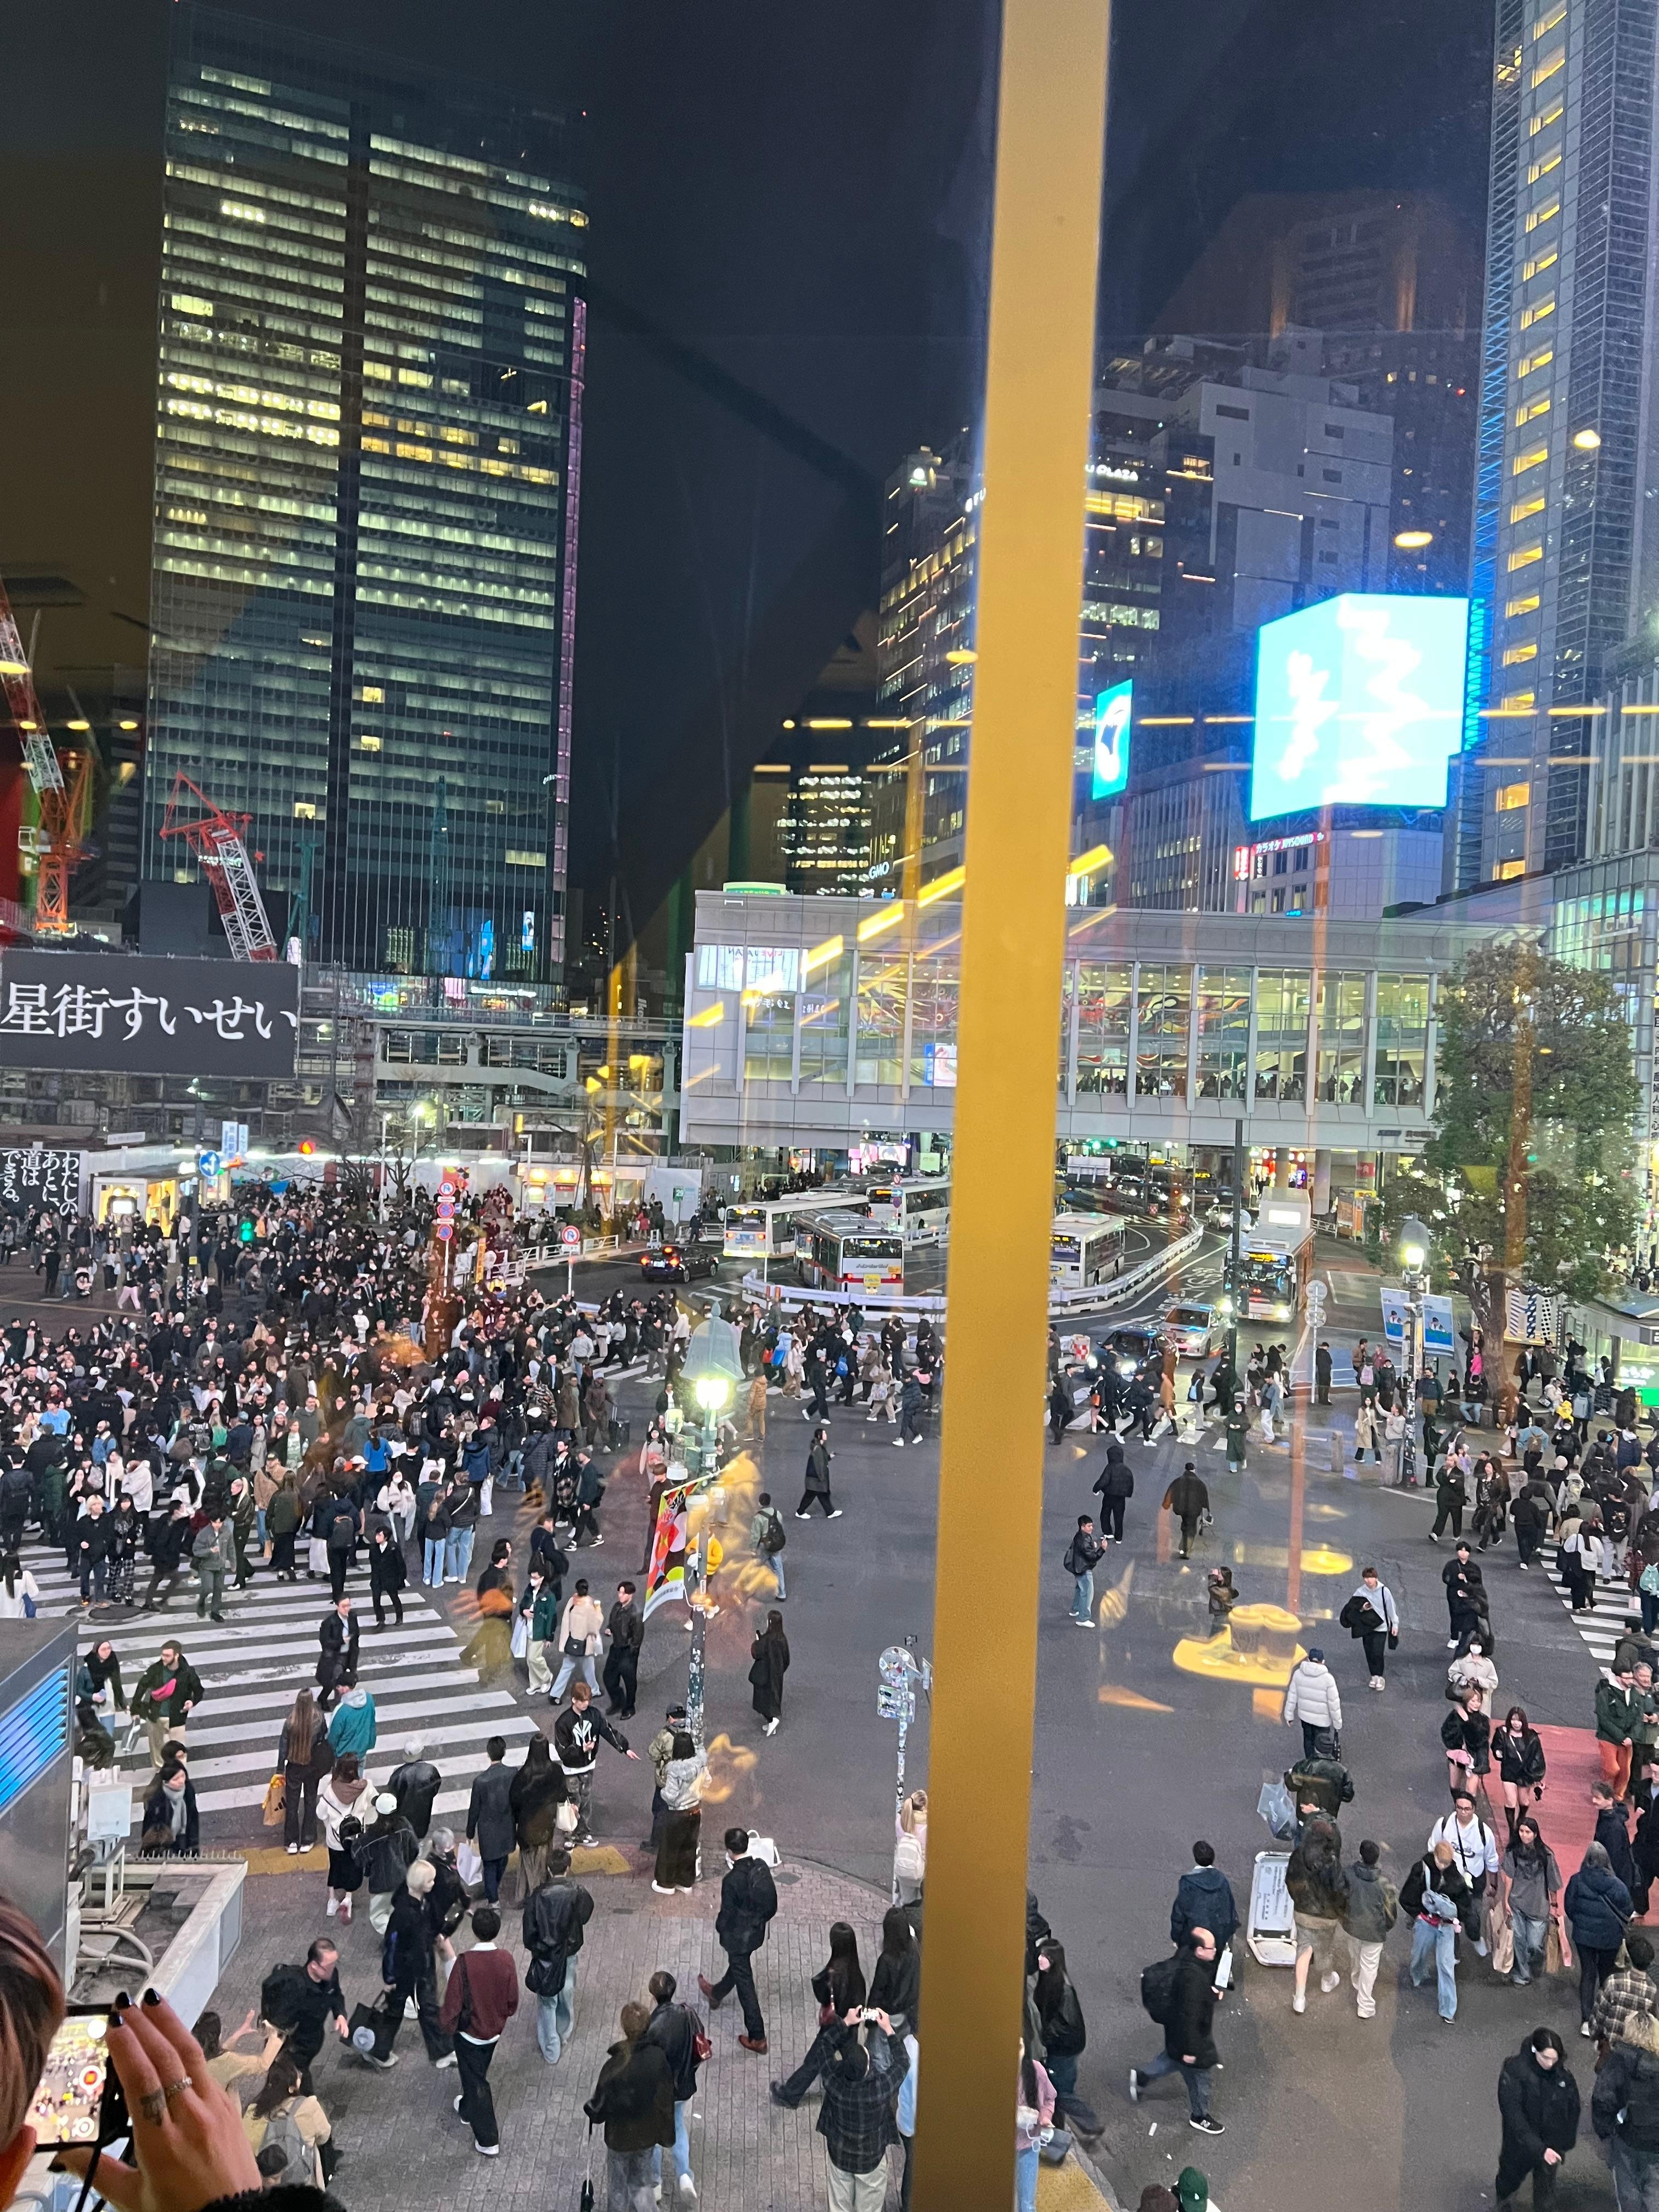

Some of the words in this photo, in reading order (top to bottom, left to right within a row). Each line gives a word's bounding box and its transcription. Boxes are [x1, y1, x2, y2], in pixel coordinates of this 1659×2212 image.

[869, 861, 889, 879] GMO
[1257, 840, 1281, 854] カラオケ
[0, 982, 297, 1041] 星街すいせい
[2, 1150, 21, 1203] できる。
[20, 1150, 42, 1186] 道は
[42, 1152, 60, 1207] あとに、
[59, 1152, 79, 1216] わたしの
